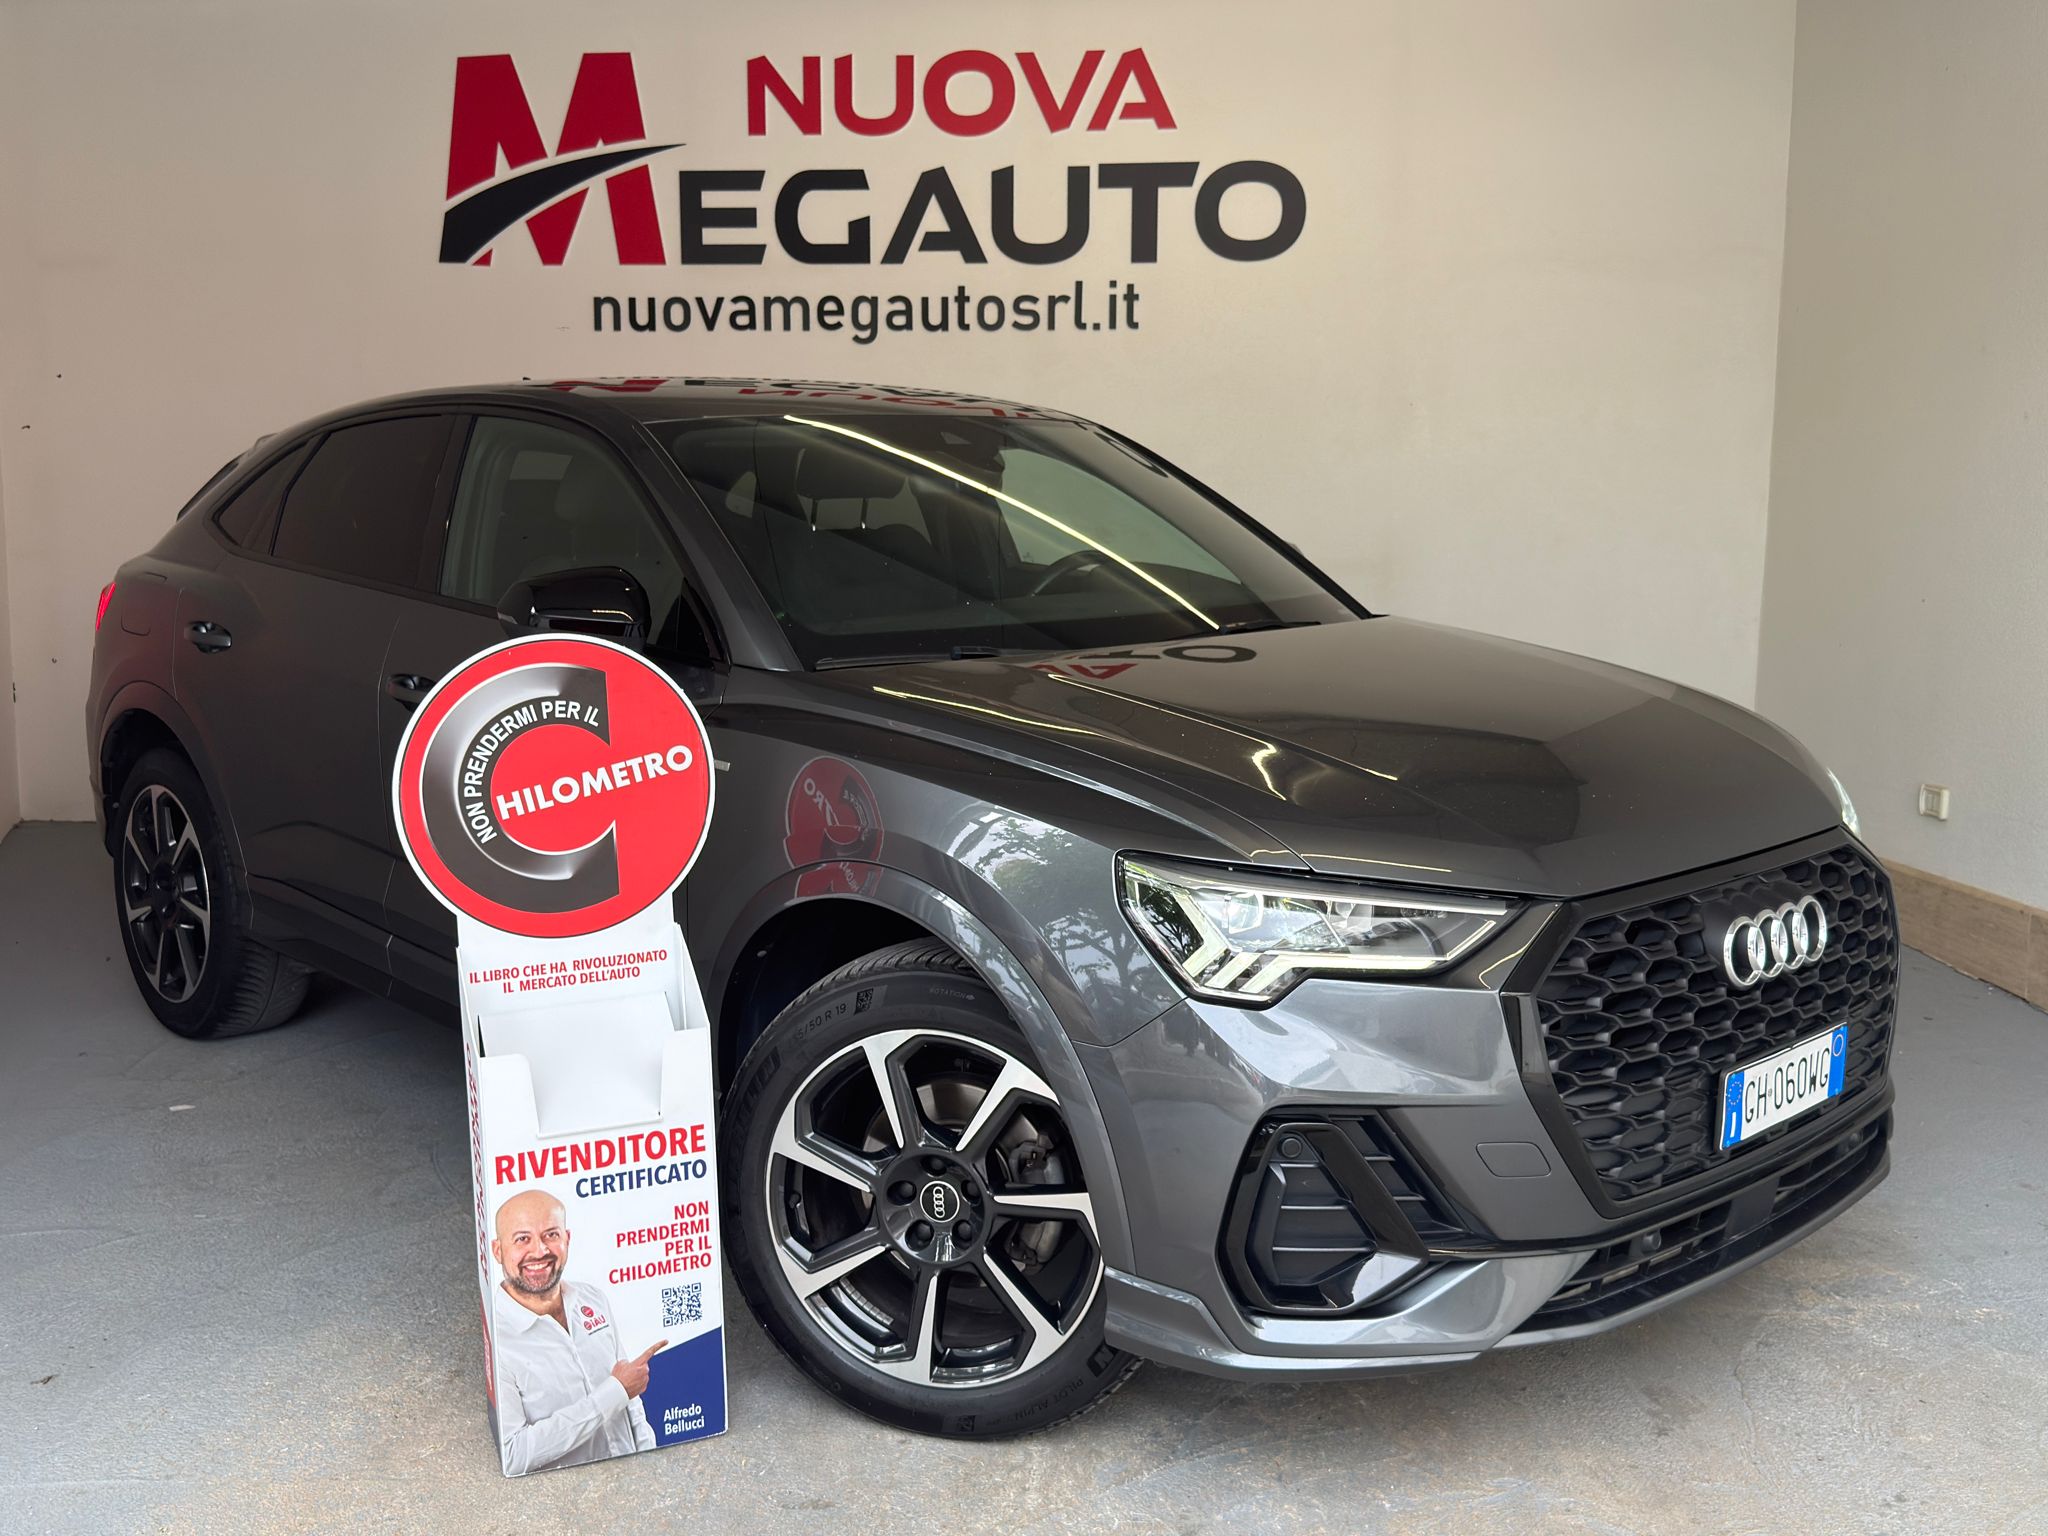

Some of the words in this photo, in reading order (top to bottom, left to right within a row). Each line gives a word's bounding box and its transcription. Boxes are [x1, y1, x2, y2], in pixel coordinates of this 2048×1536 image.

[747, 48, 1177, 137] NUOVA
[592, 280, 1140, 344] nuovamegautosrl.it
[540, 700, 581, 720] PER
[583, 704, 600, 727] IL
[463, 703, 538, 798] PRENDERMI
[465, 803, 498, 845] NON
[469, 972, 481, 984] IL
[483, 967, 520, 982] LIBRO
[523, 964, 547, 978] CHE
[550, 961, 568, 974] HA
[572, 949, 668, 971] RIVOLUZIONATO
[503, 981, 514, 994] IL
[519, 974, 577, 992] MERCATO
[580, 966, 641, 984] DELL'AUTO
[494, 1124, 706, 1185] RIVENDITORE
[575, 1159, 708, 1198] CERTIFICATO
[674, 1200, 710, 1220] NON
[616, 1218, 710, 1248] PRENDERMI
[664, 1238, 697, 1257] PER
[698, 1236, 712, 1251] IL
[608, 1252, 712, 1284] CHILOMETRO
[663, 1403, 702, 1422] Alfredo
[664, 1416, 705, 1435] Bellucci
